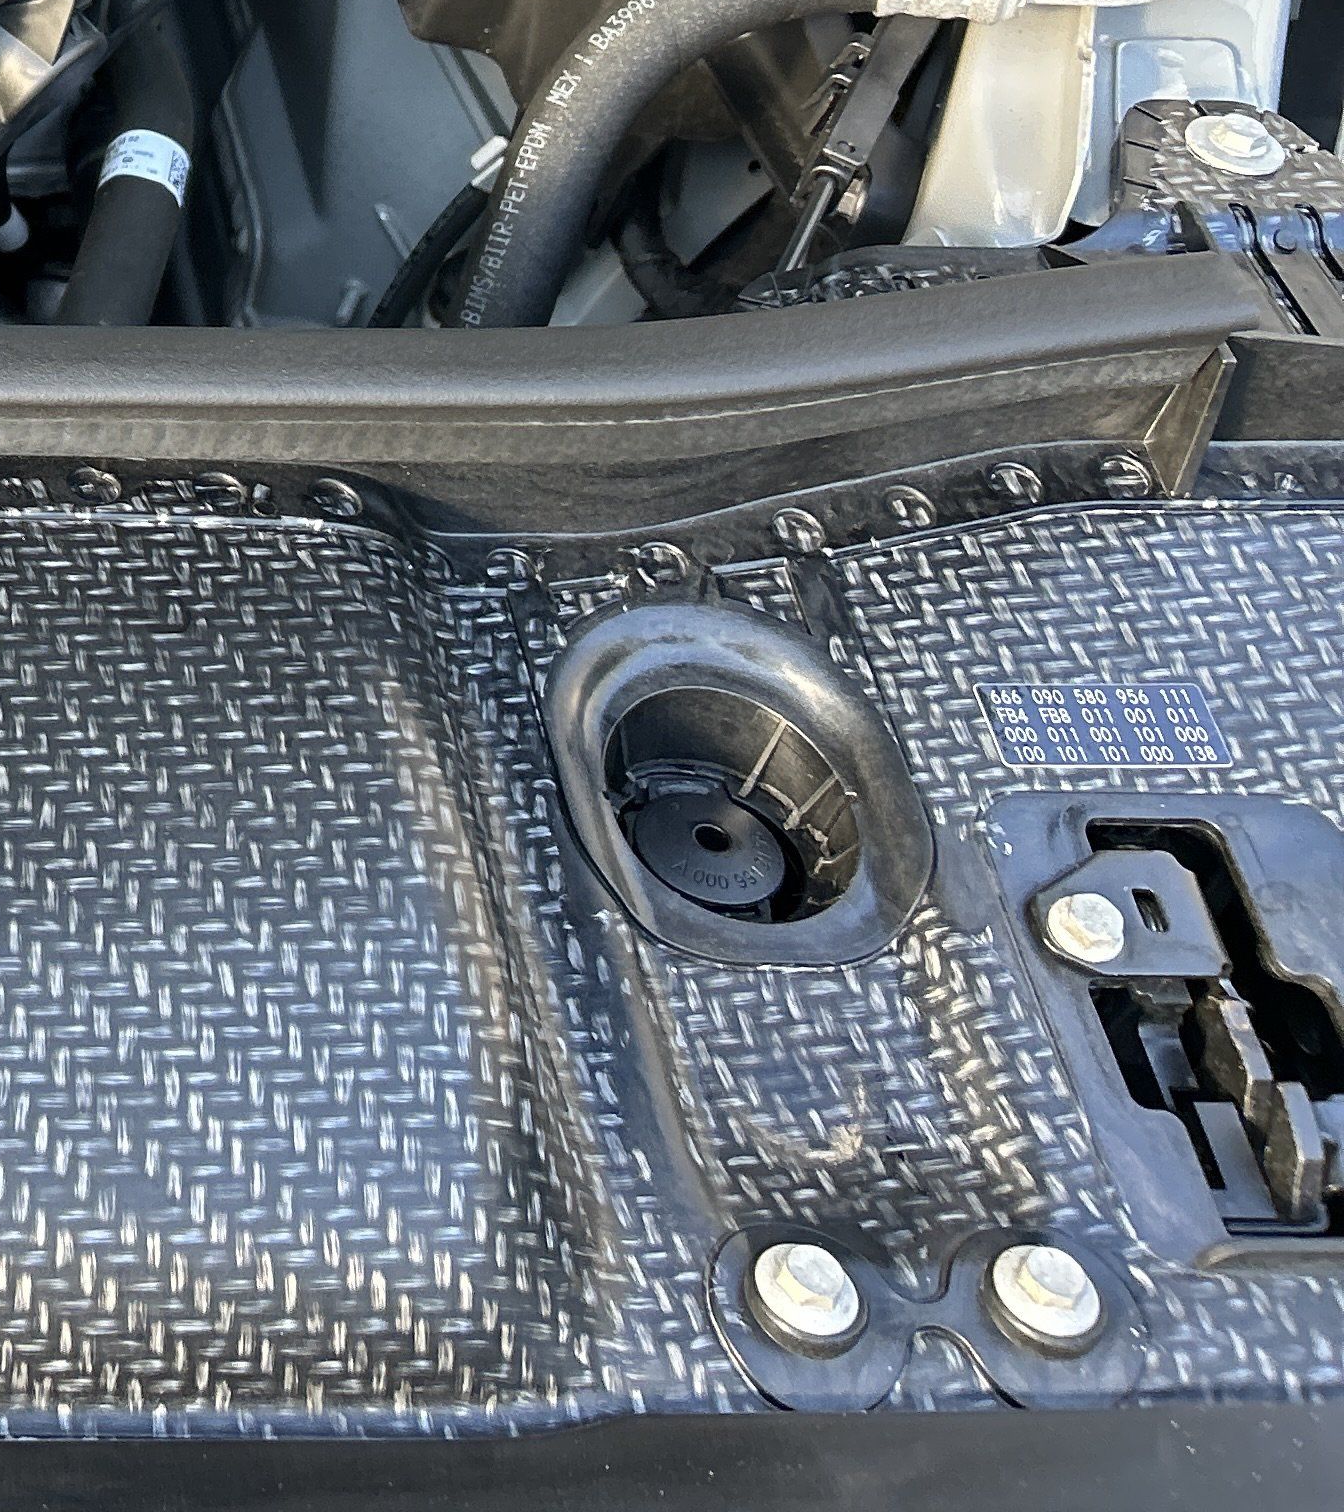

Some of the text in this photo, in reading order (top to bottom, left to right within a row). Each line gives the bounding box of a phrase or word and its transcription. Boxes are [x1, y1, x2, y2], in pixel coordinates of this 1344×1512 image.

[546, 69, 582, 108] MEX
[991, 688, 1191, 705] 666 090 580 956 111
[996, 707, 1199, 724] FB4 FB8 011 001 011
[1004, 726, 1209, 743] 000 011 001 101 000
[1014, 745, 1218, 762] 100 101 101 000 138
[693, 869, 730, 890] 000
